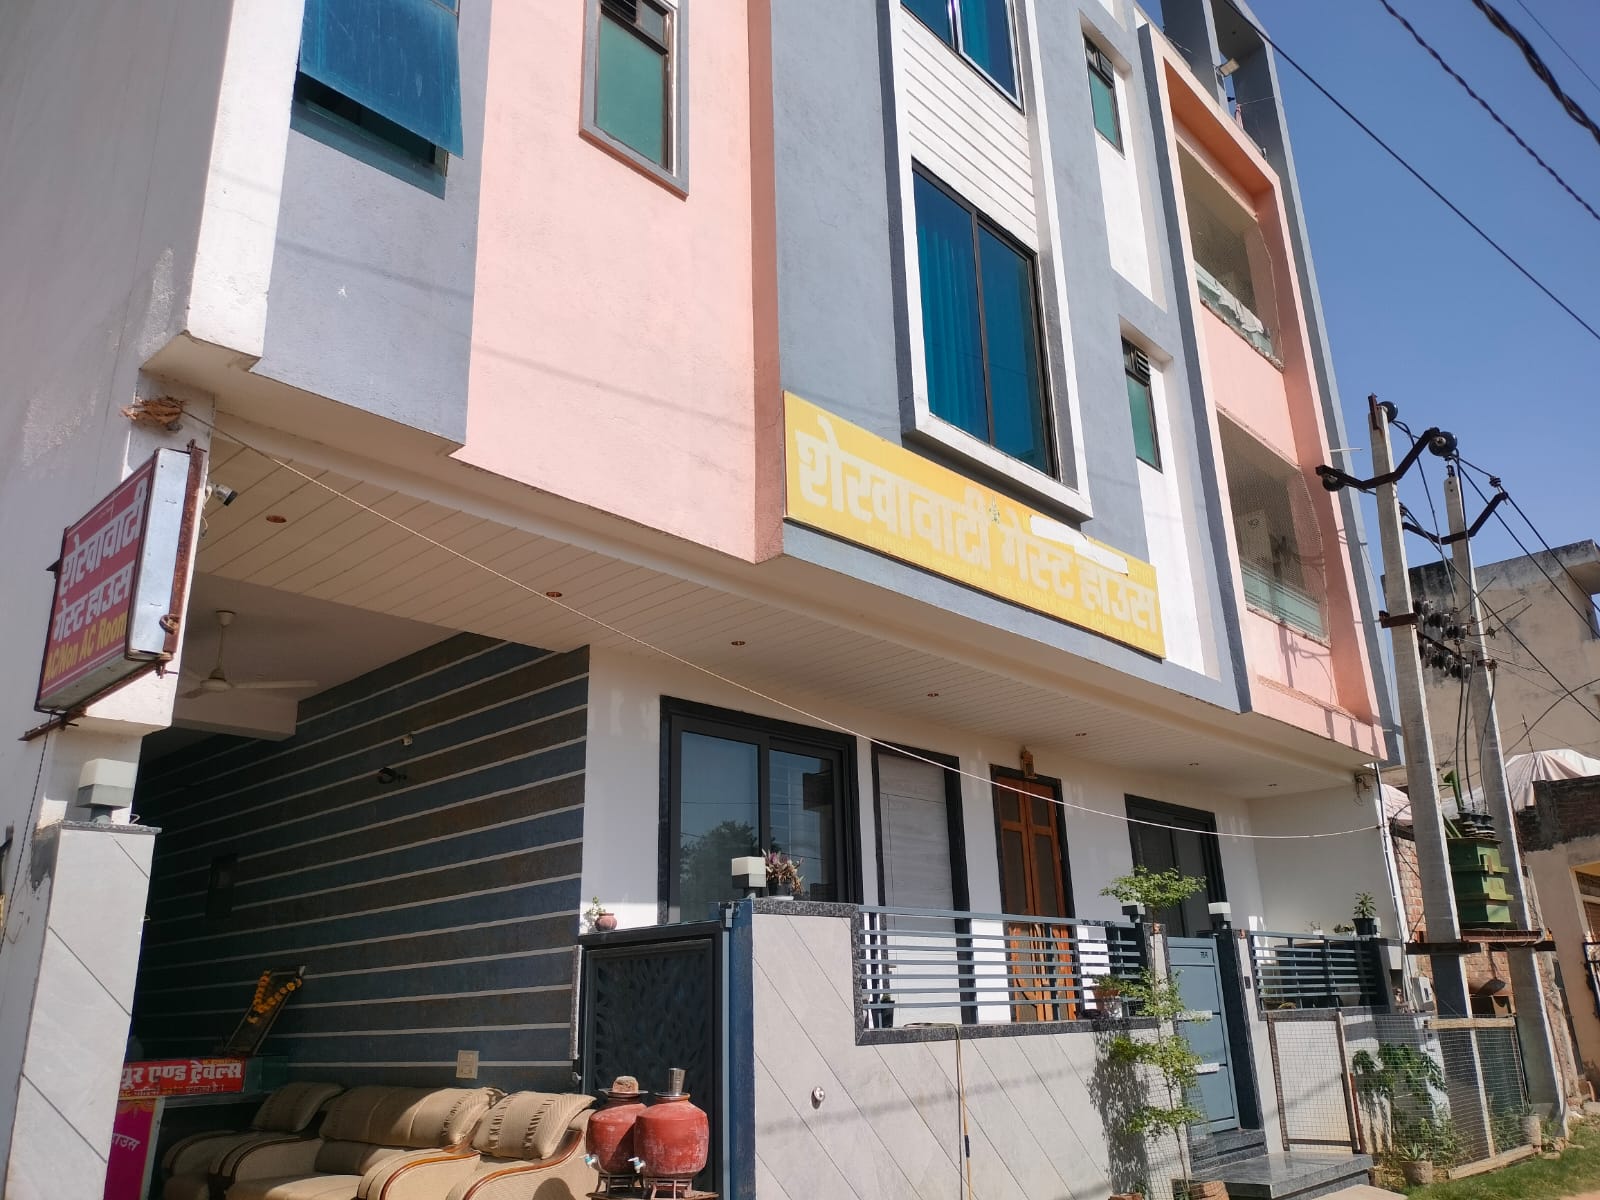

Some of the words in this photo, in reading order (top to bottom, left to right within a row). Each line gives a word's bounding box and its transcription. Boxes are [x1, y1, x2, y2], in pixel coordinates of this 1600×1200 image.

[60, 479, 148, 596] शेखावाटी
[795, 416, 992, 570] शेखावाटी
[1000, 514, 1075, 599] गेस्ट
[1078, 559, 1157, 633] हाउस
[86, 561, 135, 626] हाउस
[54, 600, 86, 641] गेस्ट
[79, 624, 97, 661] AC
[111, 1133, 141, 1151] ाउस
